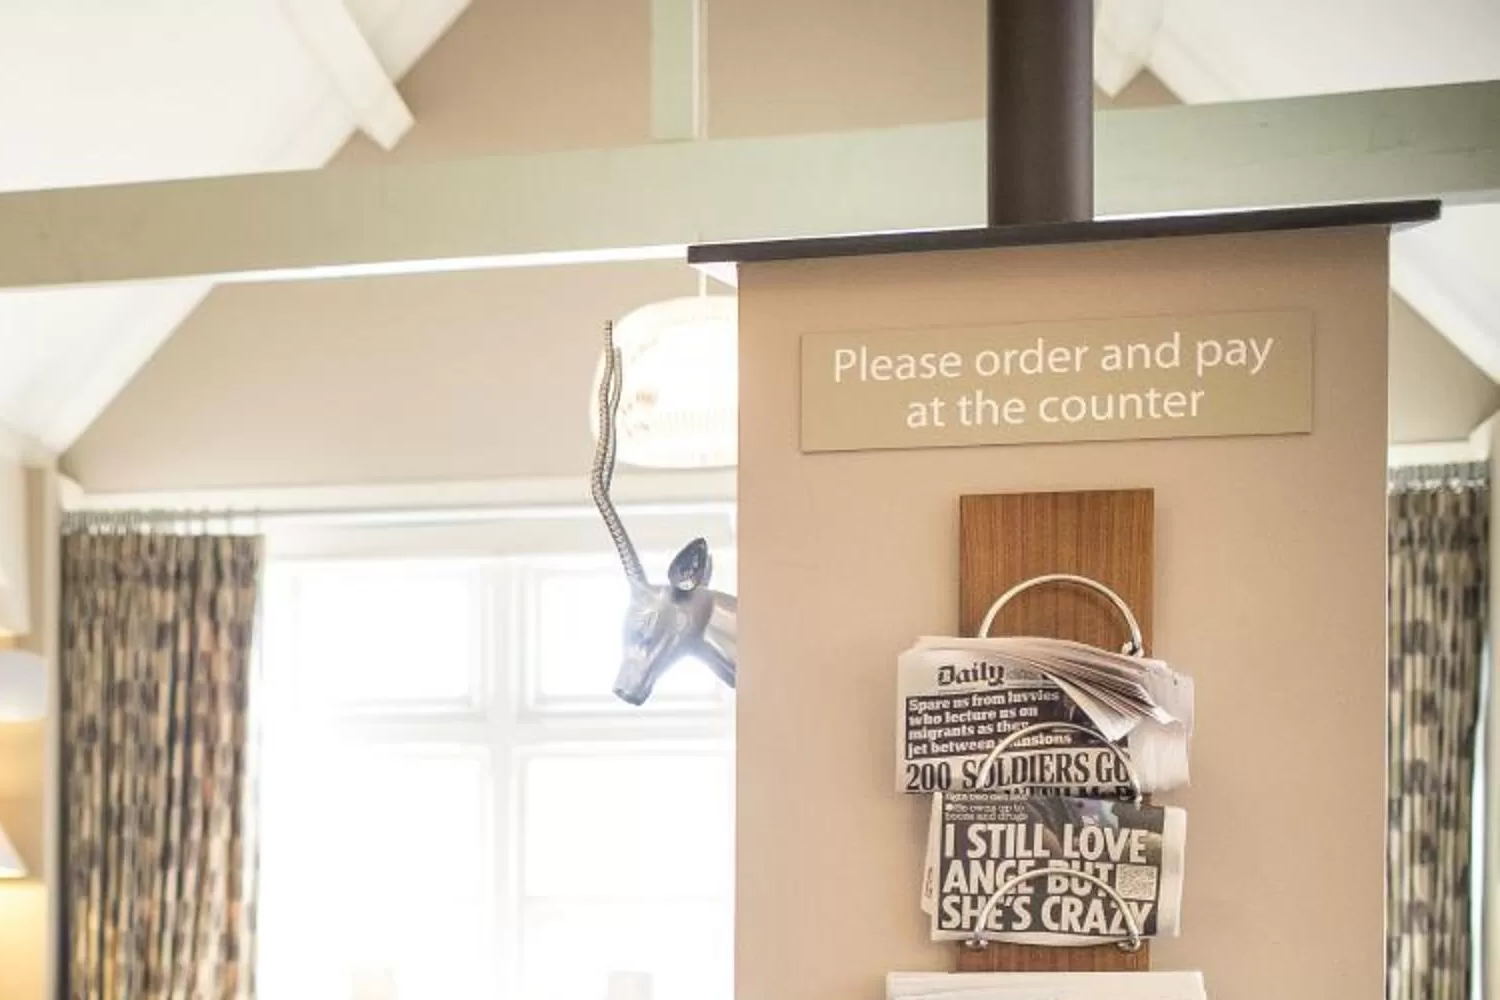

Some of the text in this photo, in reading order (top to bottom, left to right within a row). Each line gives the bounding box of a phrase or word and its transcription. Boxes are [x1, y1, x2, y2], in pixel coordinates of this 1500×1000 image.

[833, 332, 1274, 382] Please order and pay
[906, 387, 1205, 429] at the counter
[938, 662, 1004, 686] Daily
[908, 699, 950, 714] Spare
[972, 693, 1006, 707] from
[908, 713, 942, 726] who
[945, 709, 996, 723] lecture
[1019, 706, 1038, 717] on
[906, 733, 1072, 760] jet between ansions
[908, 724, 975, 742] migrants
[977, 722, 994, 735] as
[906, 761, 951, 790] 200
[962, 752, 1091, 789] SOLDIERS
[944, 823, 1149, 863] I STILL LOVE
[942, 859, 1035, 895] ANGE
[1047, 862, 1113, 897] BUT
[941, 895, 1153, 936] SHE'S CRAZY
